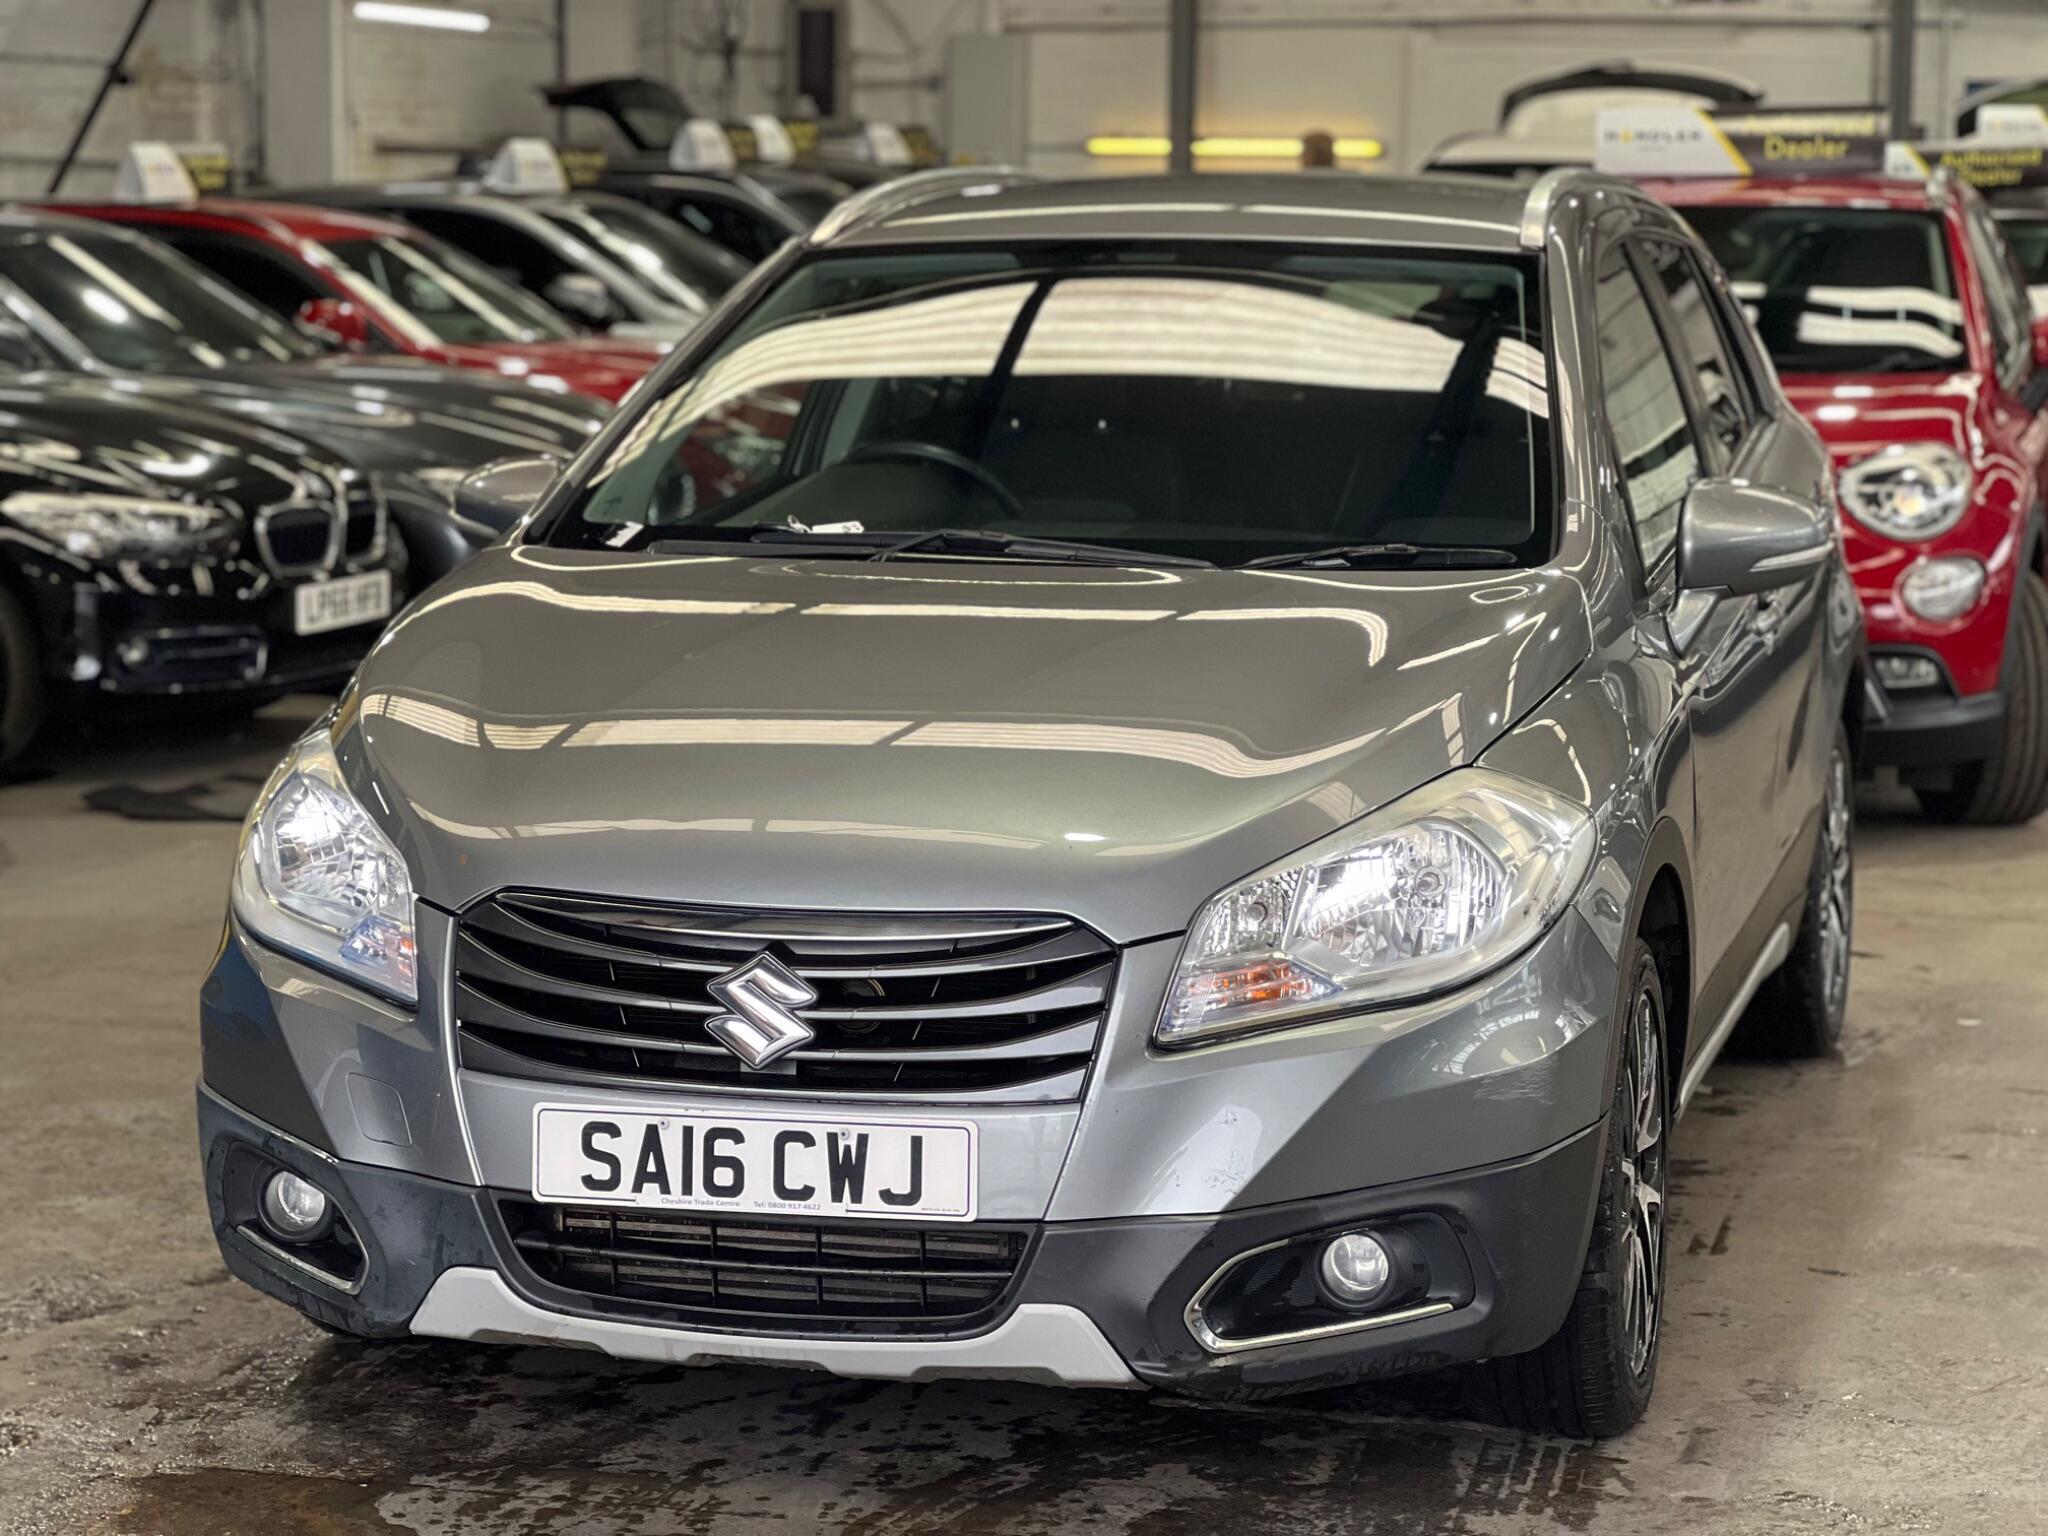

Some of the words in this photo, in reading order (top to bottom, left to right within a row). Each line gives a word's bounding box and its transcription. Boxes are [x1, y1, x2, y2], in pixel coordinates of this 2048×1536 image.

[1763, 134, 1848, 160] Dealer
[581, 1121, 746, 1198] SA16
[772, 1130, 924, 1206] CWJ
[660, 1197, 692, 1205] Cheshire
[694, 1198, 714, 1206] Trade
[715, 1199, 740, 1207] Centre
